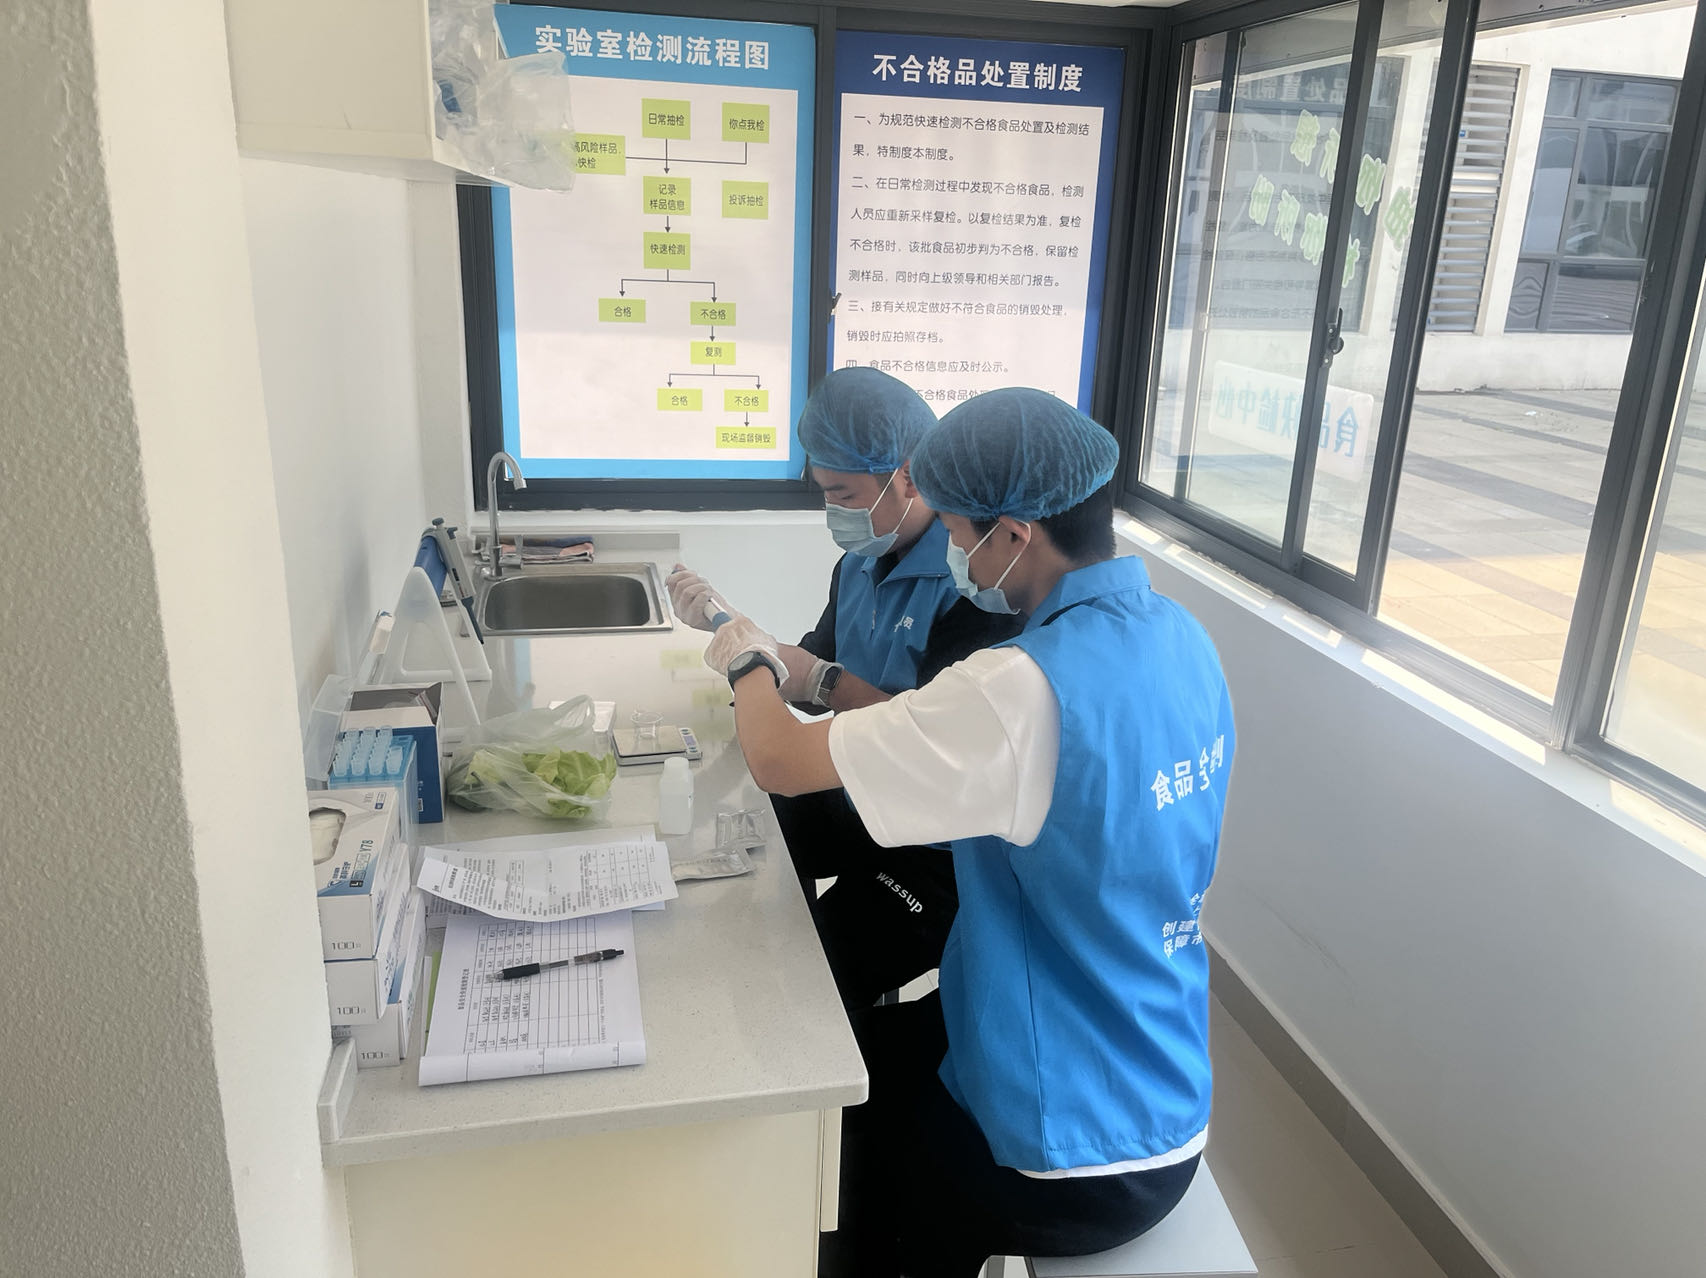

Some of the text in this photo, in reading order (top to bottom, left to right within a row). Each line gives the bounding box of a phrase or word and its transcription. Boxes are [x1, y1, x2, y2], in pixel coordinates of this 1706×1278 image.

[535, 24, 770, 70] 实验室检测流程图
[872, 53, 1084, 93] 不合格品处置制度
[648, 112, 685, 127] 日常抽检
[729, 118, 766, 132] 你点我检
[854, 112, 1090, 136] 一、为规范快速检测不合格食品处置及检测结
[852, 144, 955, 162] 果，特制度本制度。
[576, 157, 597, 169] 快检
[658, 183, 677, 196] 记录
[851, 176, 1085, 198] 二、在日常检测过程中发现不合格食品，检测
[649, 199, 686, 211] 样品信息
[729, 194, 765, 207] 投诉抽检
[850, 207, 1082, 229] 人员应重新采样复检。以复检结果为准，复检
[650, 243, 686, 256] 快速检测
[849, 238, 1080, 258] 不合格时，该批食品初步判为不合格，保留检
[848, 270, 1062, 288] 测样品，同时向上级领导和相关部门报告。
[614, 306, 632, 318] 合格
[700, 309, 727, 321] 不合格
[846, 329, 945, 344] 销毁时应拍照存档。
[704, 347, 722, 359] 复测
[671, 395, 688, 407] 合格
[735, 396, 759, 407] 不合格
[721, 432, 771, 444] 现场监督销毁
[876, 872, 923, 913] wassup
